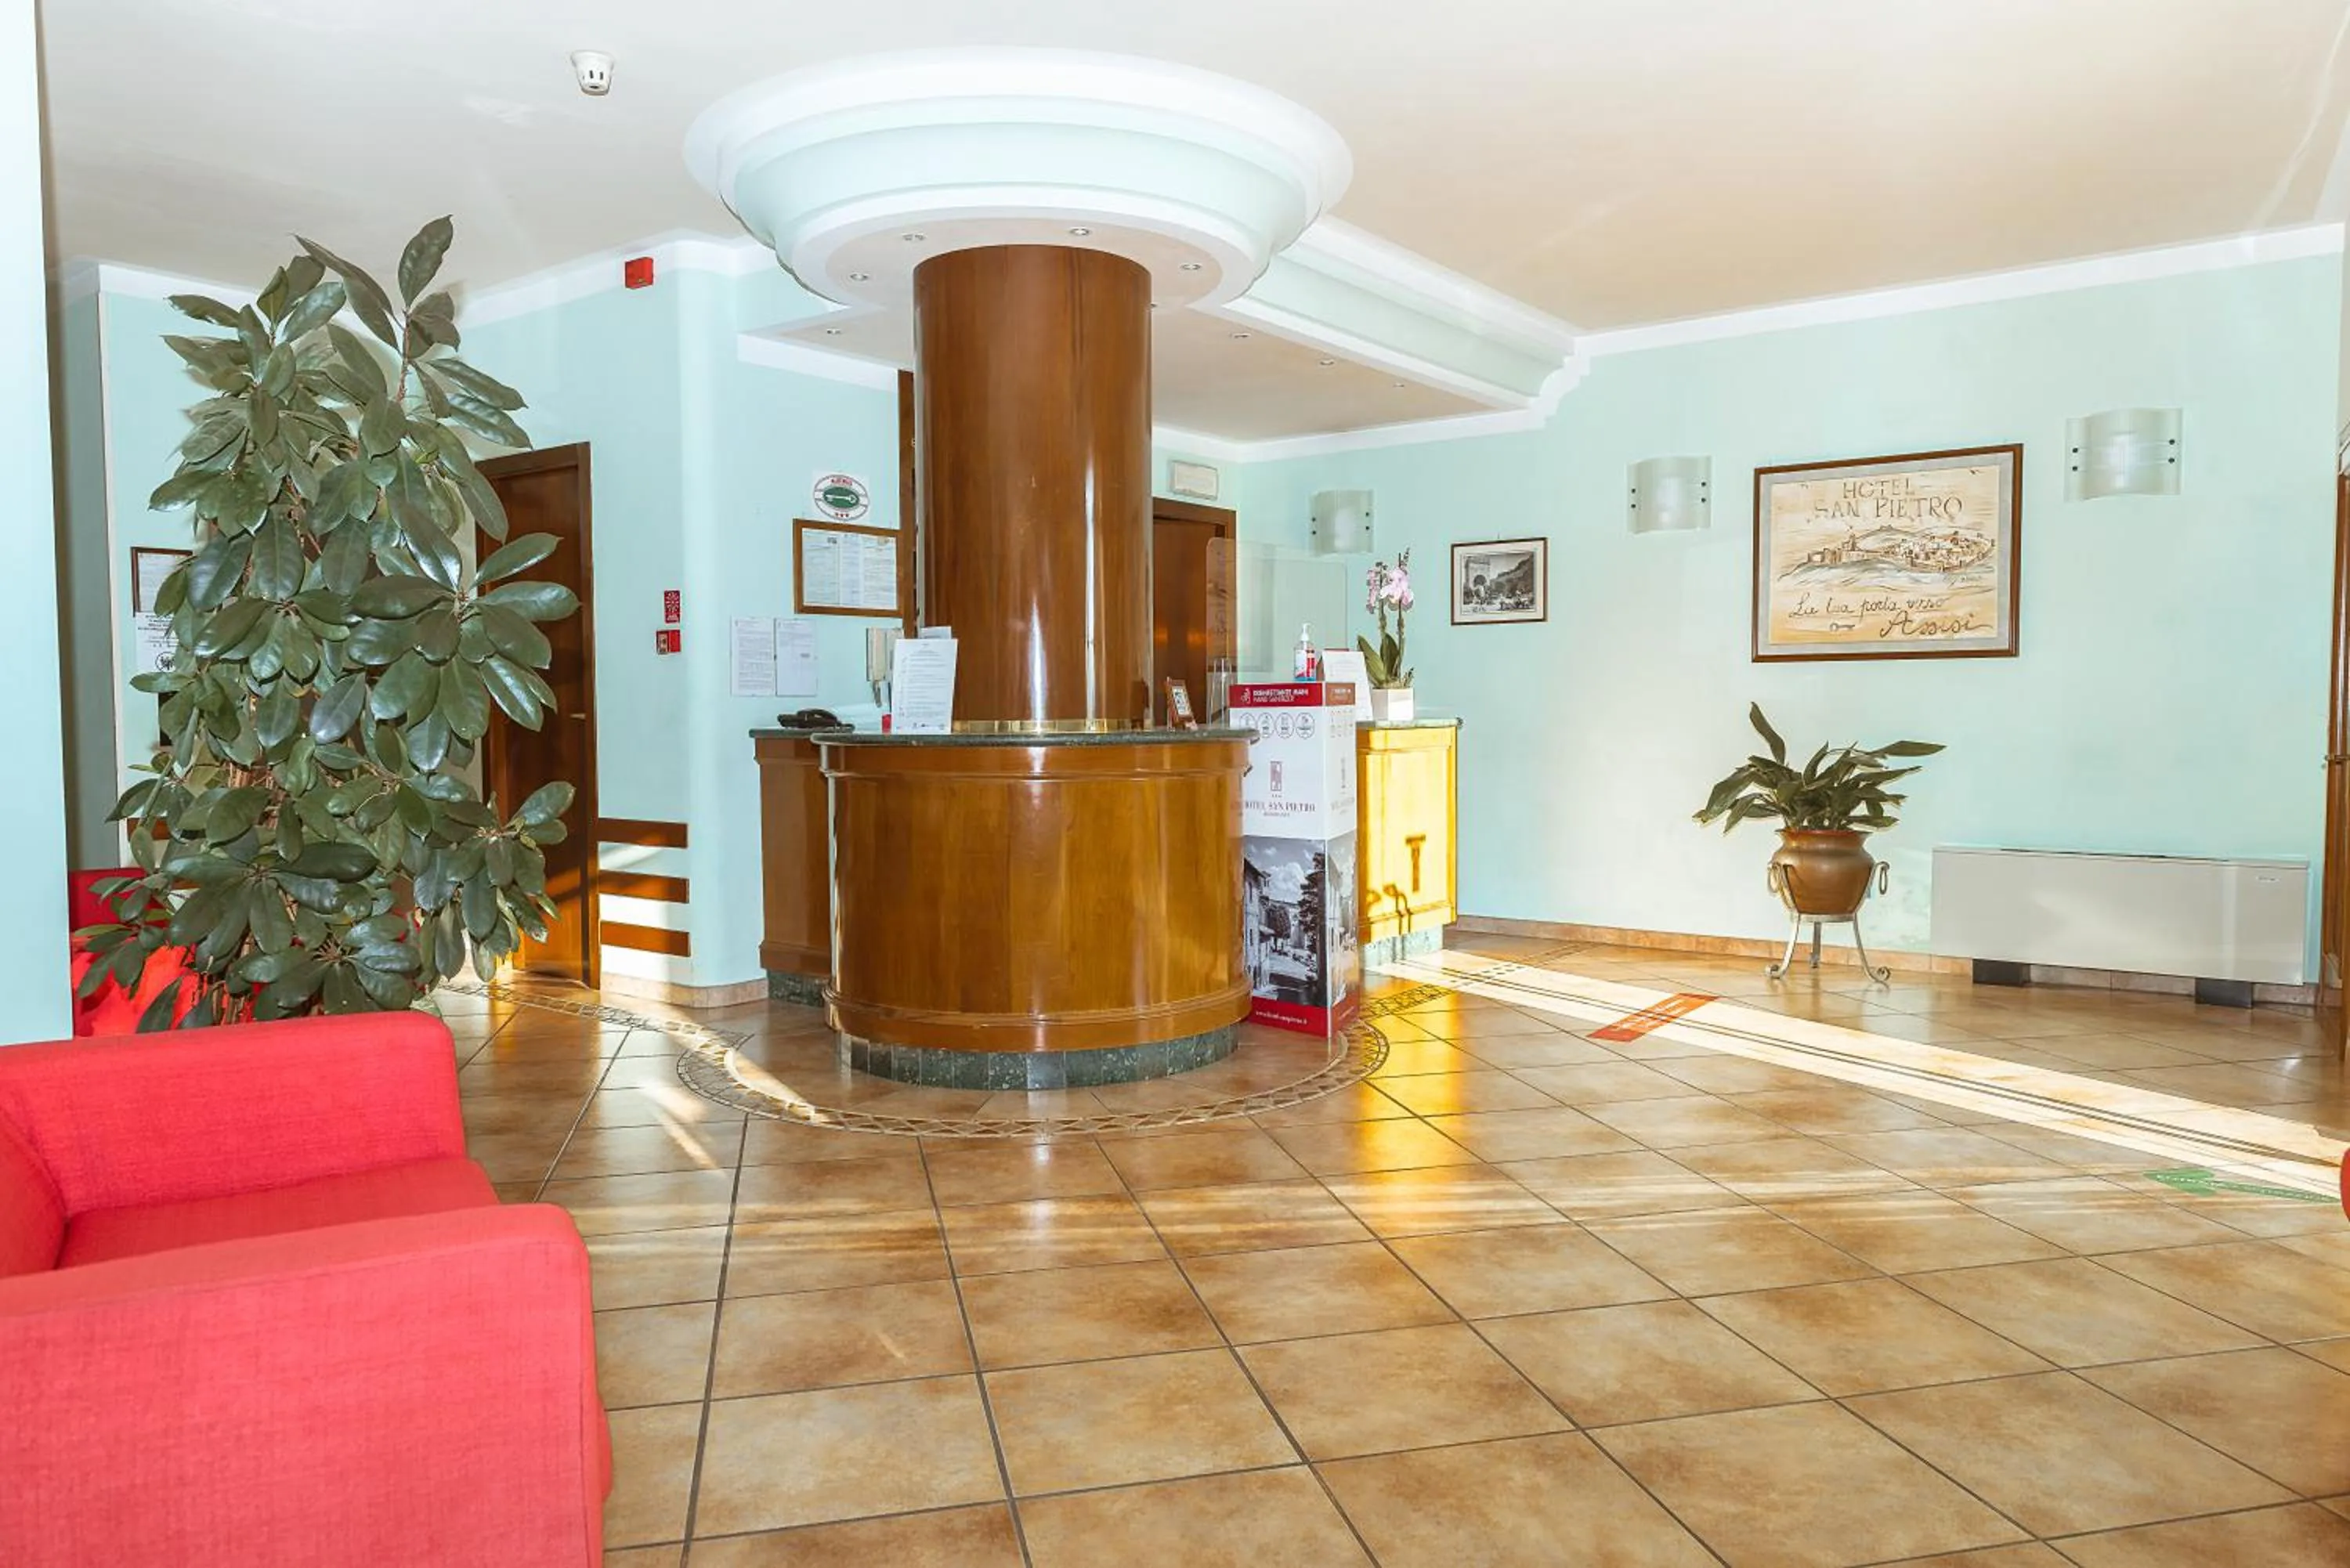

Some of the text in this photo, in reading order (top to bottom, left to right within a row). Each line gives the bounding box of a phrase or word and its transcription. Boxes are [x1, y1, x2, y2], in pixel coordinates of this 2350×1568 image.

[1842, 478, 1915, 499] HOTEL
[1813, 496, 1962, 518] SAN PIETRO
[1859, 595, 1902, 623] porta
[1880, 610, 1991, 638] Assisi
